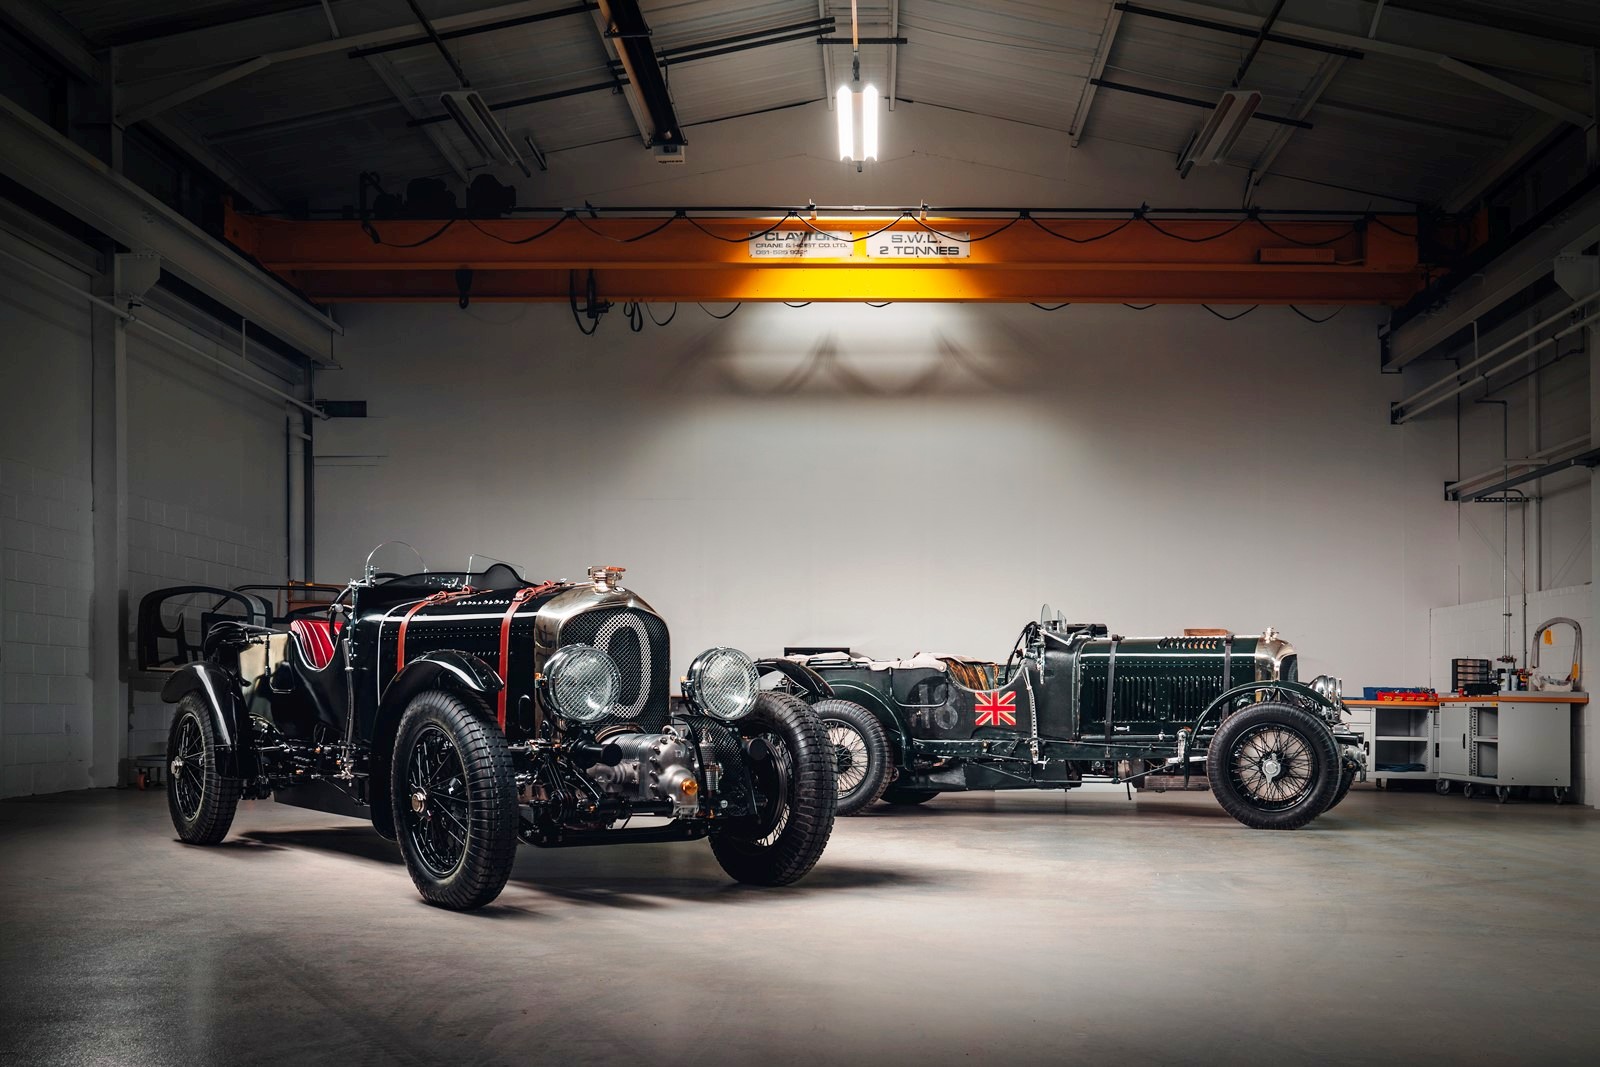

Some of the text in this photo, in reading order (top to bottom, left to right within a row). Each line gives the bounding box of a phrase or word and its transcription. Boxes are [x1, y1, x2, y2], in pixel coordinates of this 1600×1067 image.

[891, 234, 942, 244] S.W.L.
[879, 246, 960, 256] 2 TONNES
